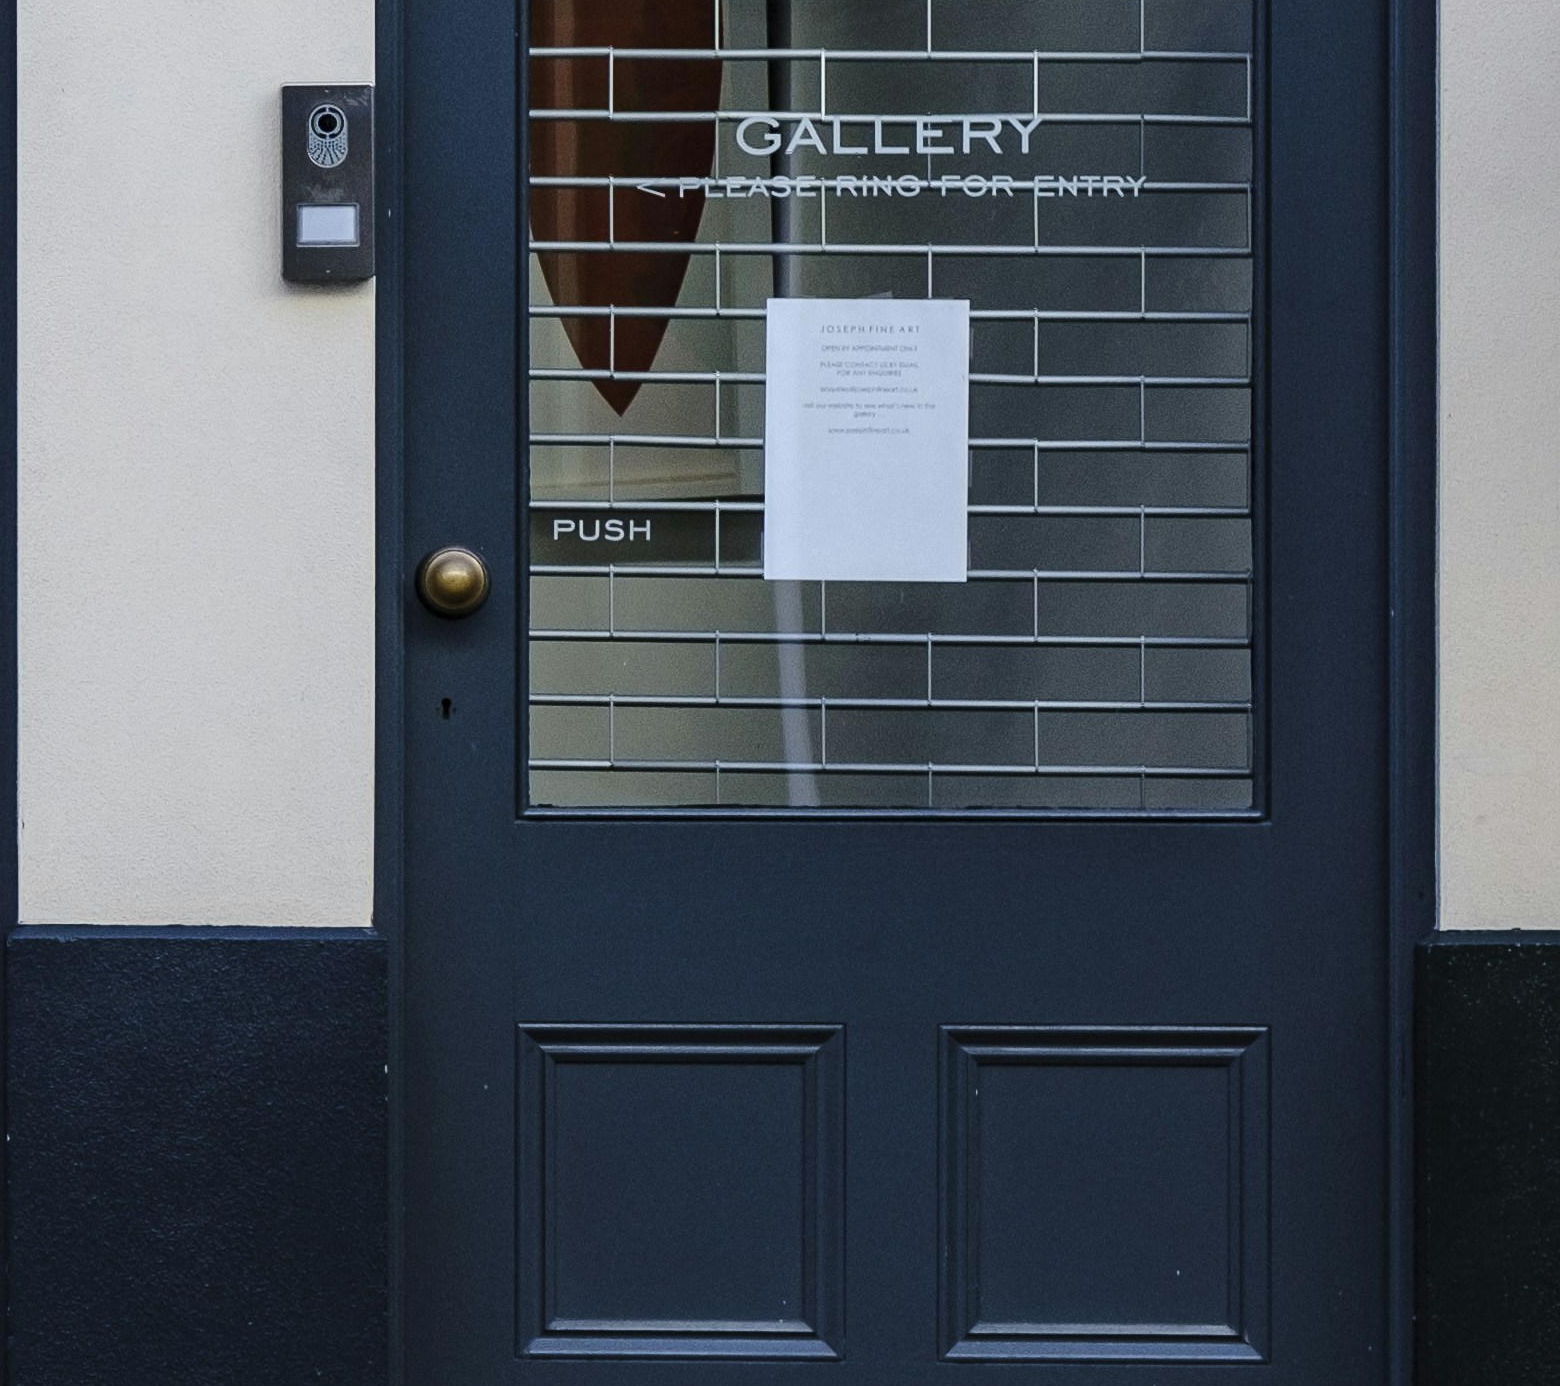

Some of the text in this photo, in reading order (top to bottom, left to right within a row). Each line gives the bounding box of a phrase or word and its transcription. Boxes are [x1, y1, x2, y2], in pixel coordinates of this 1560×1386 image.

[736, 115, 1045, 155] GALLERY
[679, 175, 1147, 198] PLEASE RING FOR ENTRY
[821, 324, 920, 334] JOSEPH FINE ART
[553, 519, 653, 543] PUSH
